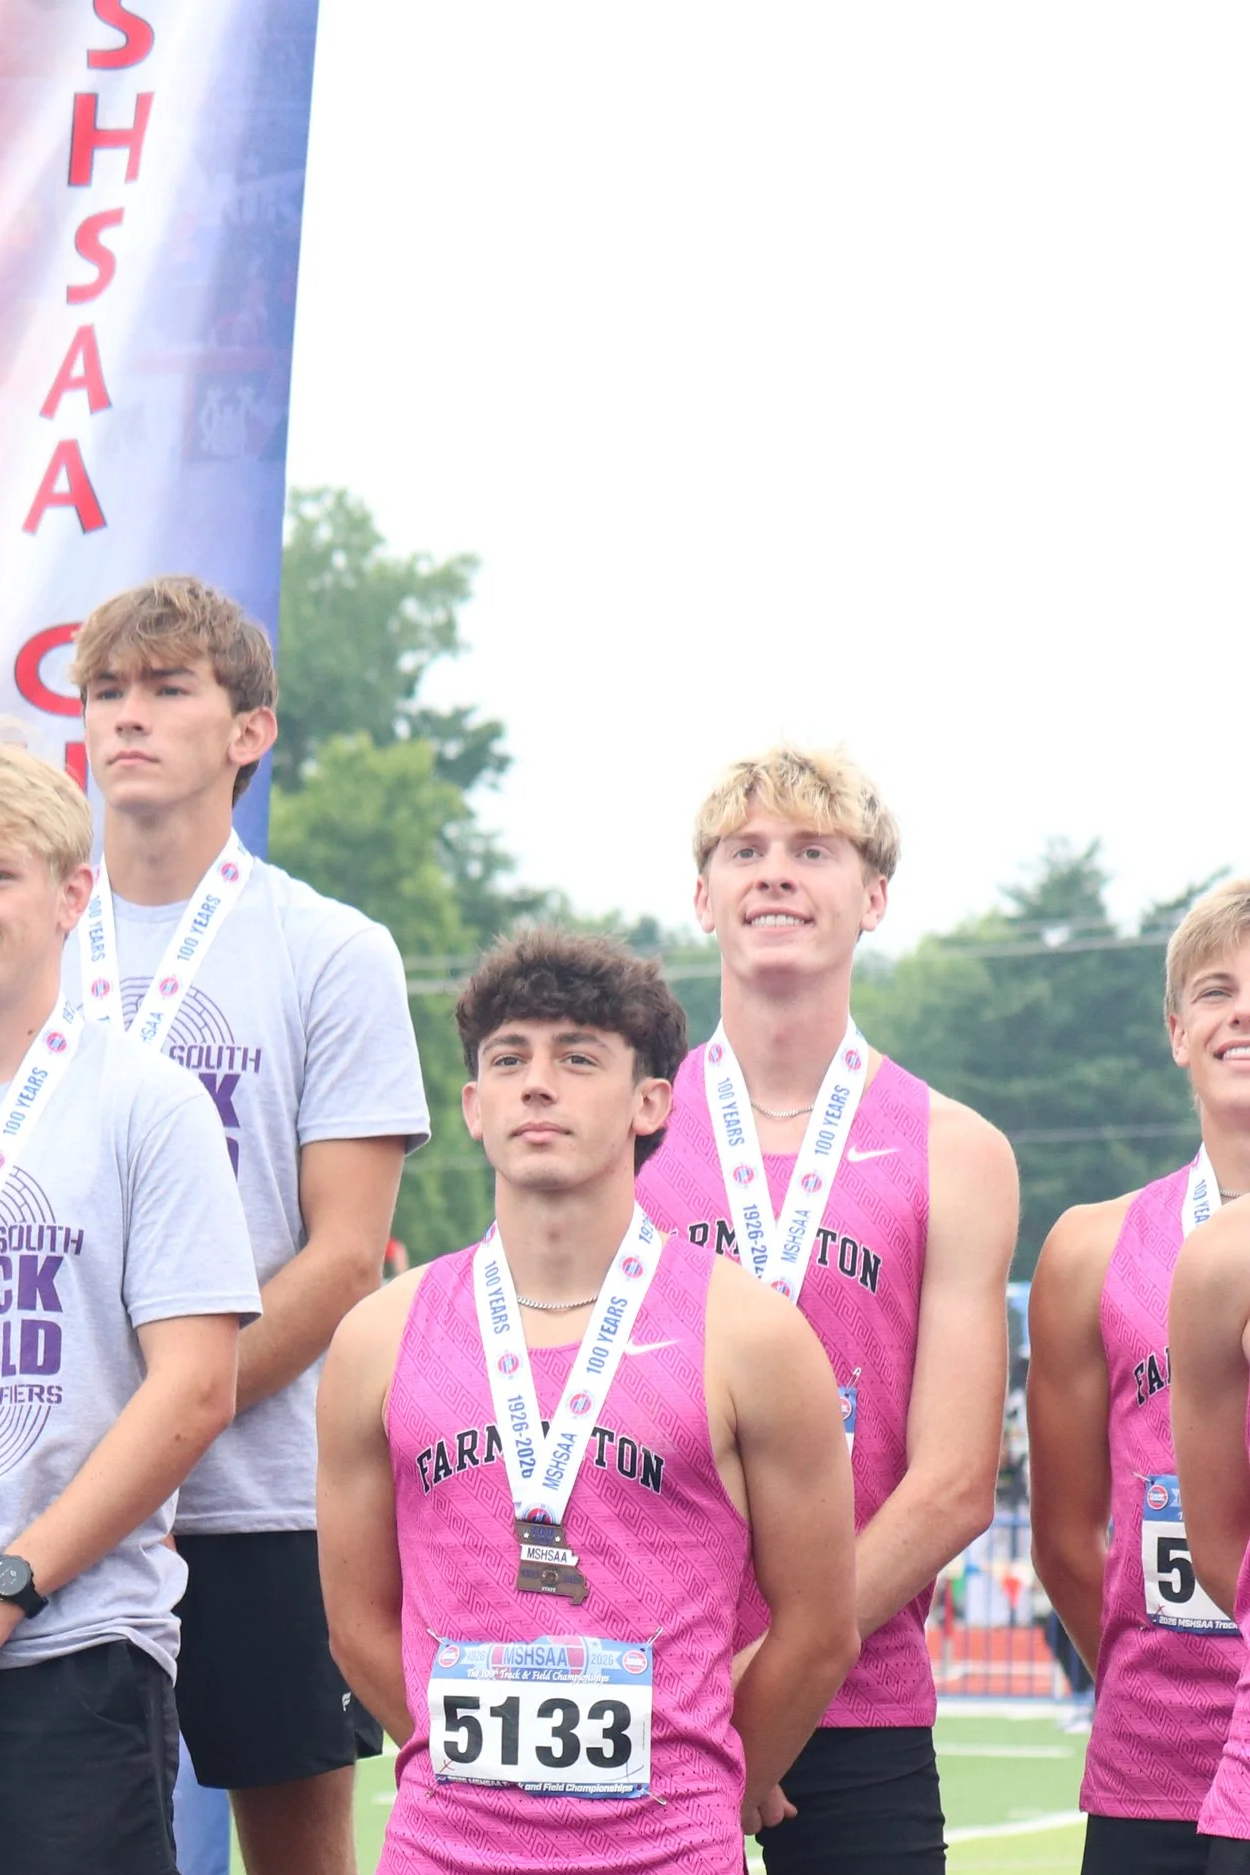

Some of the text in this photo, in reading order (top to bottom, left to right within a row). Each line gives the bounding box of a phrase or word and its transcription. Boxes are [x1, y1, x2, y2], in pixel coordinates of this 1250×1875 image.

[190, 894, 222, 935] YEARS
[3, 1066, 49, 1136] 100 YEARS
[717, 1077, 746, 1148] 100 YEARS
[814, 1084, 851, 1156] 100 YEARS
[780, 1209, 812, 1264] MSHSAA
[484, 1259, 510, 1335] 100 YEARS
[586, 1295, 628, 1375] 100 YEARS
[542, 1431, 578, 1491] MSHSAA
[526, 1546, 568, 1564] MSHSAA
[1178, 1617, 1214, 1630] MSHSAA
[500, 1668, 520, 1681] Track
[532, 1670, 550, 1681] Field
[552, 1671, 611, 1687] Championships
[503, 1645, 568, 1667] MSHSAA
[590, 1653, 614, 1667] 2026
[442, 1694, 632, 1770] 5133
[524, 1782, 542, 1792] and
[543, 1782, 565, 1793] Field
[565, 1783, 634, 1794] Championships
